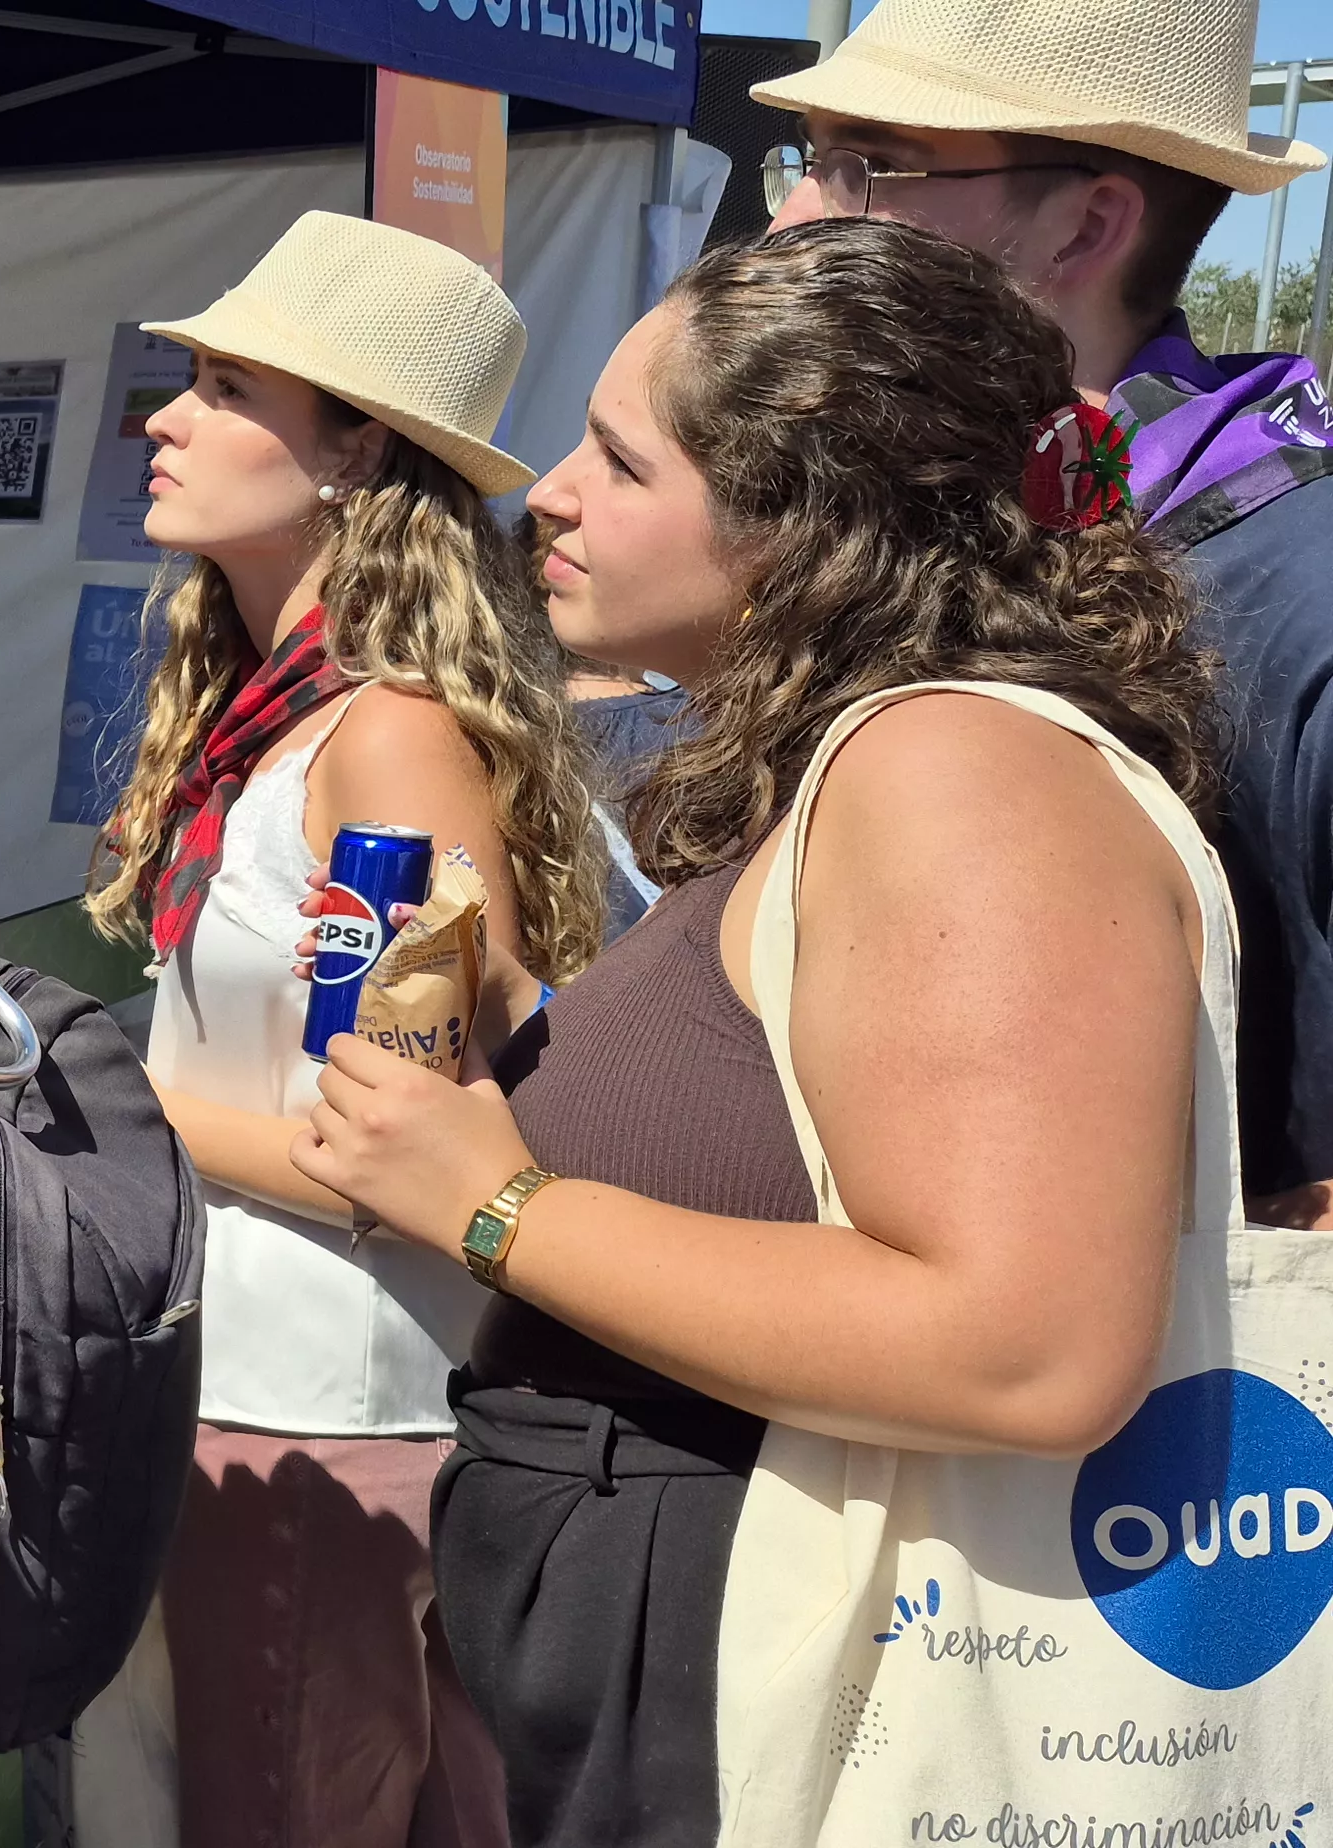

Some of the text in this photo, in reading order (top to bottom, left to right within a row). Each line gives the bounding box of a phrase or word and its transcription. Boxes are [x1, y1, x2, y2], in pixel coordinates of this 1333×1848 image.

[415, 142, 472, 174] Observatorio
[412, 175, 474, 205] Sostenibilidad
[85, 642, 116, 663] al
[921, 1621, 1069, 1675] respeto
[1040, 1718, 1238, 1768] inclusión
[911, 1796, 1282, 1848] no discriminación
